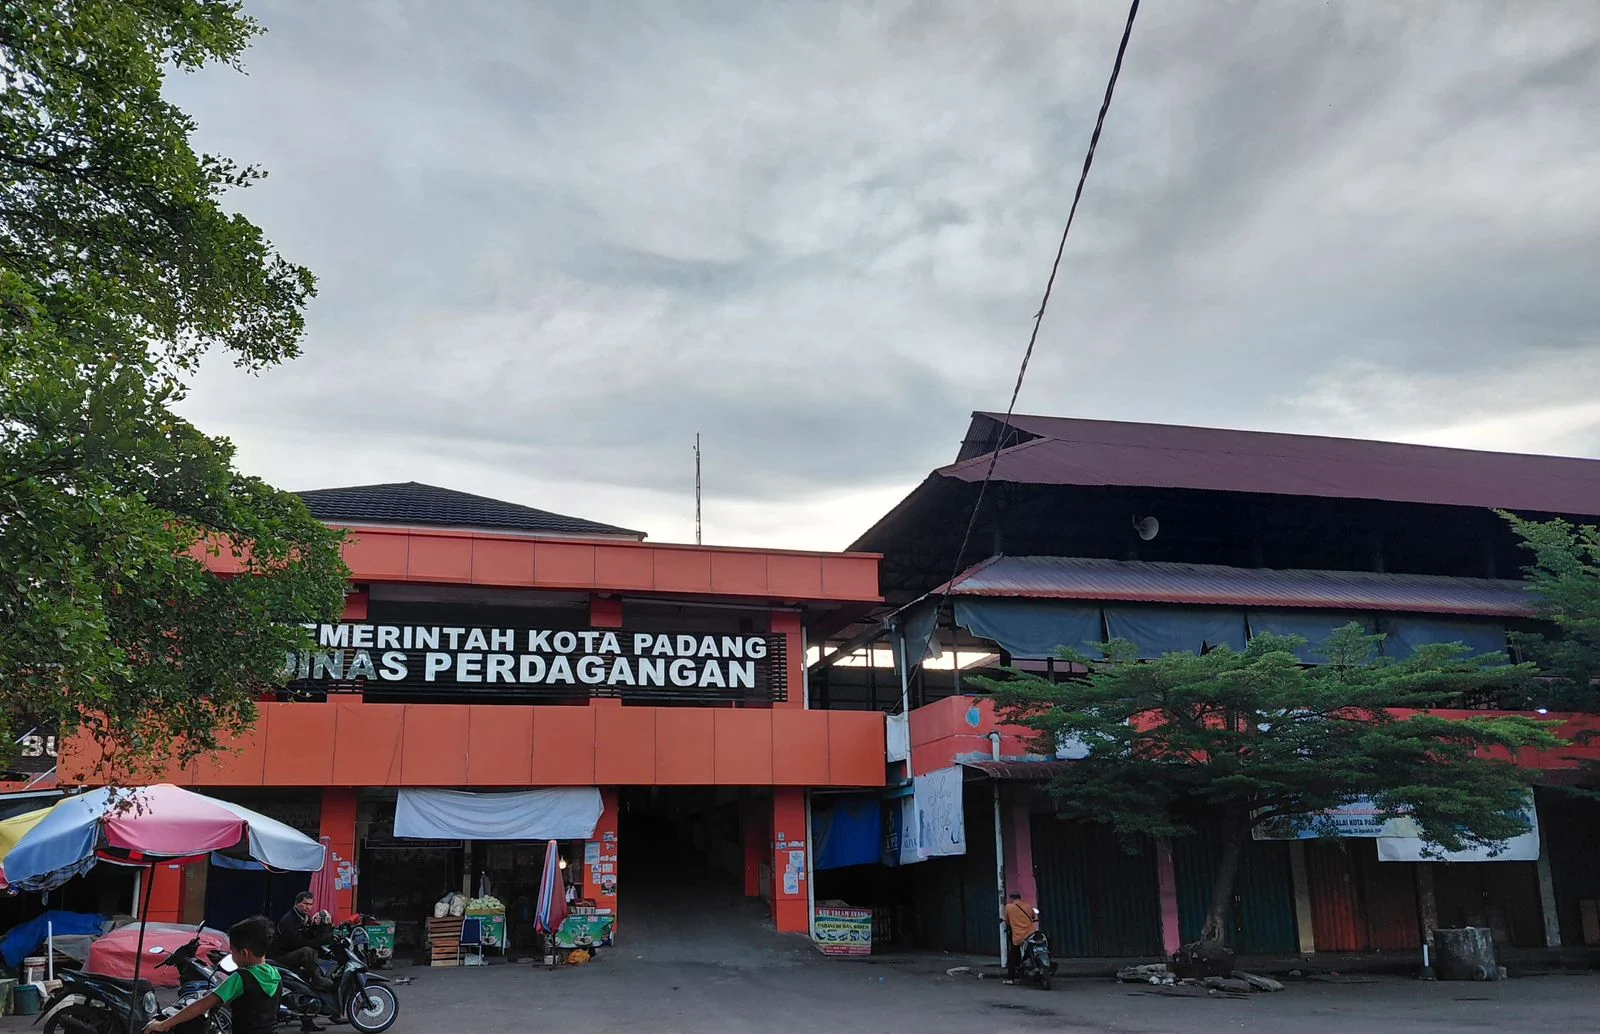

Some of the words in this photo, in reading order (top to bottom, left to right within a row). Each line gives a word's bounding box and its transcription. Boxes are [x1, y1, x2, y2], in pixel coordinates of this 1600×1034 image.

[271, 622, 515, 651] MERINTAH
[528, 629, 622, 654] KOTA
[633, 633, 767, 659] PADANG
[424, 651, 755, 689] PERDAGANGAN
